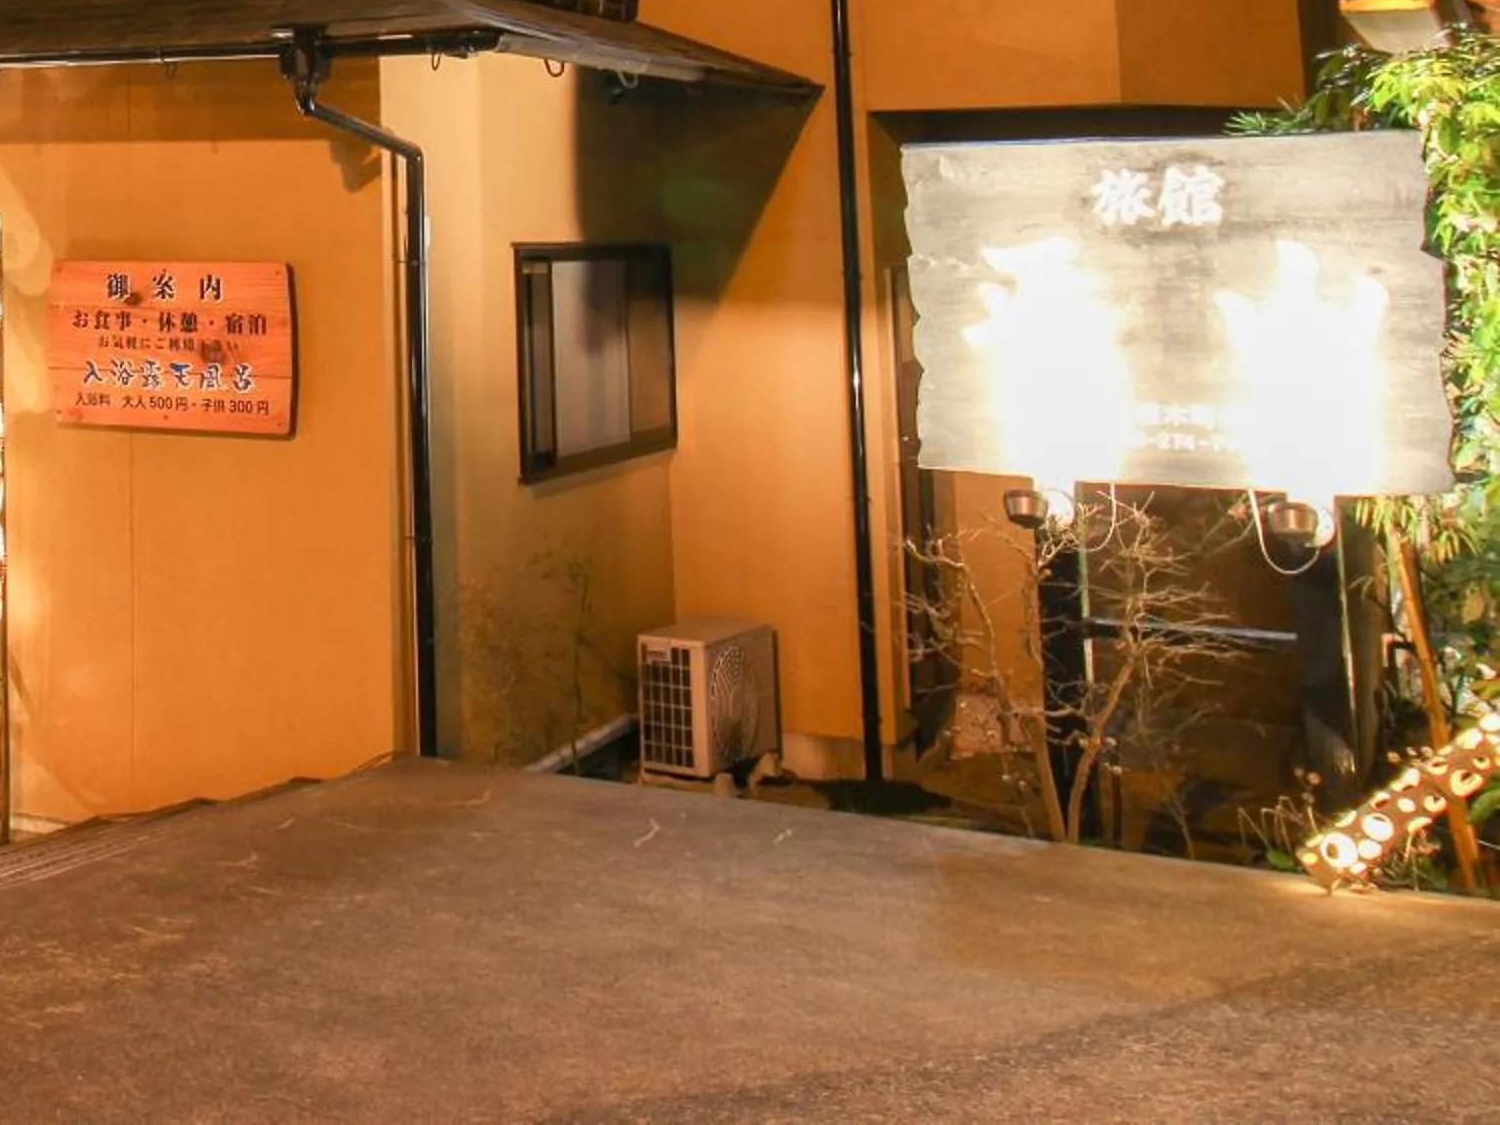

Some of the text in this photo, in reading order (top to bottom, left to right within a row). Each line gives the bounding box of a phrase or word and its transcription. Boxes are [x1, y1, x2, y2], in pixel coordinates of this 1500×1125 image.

[1091, 163, 1226, 228] 旅館
[106, 271, 224, 302] 御案内
[83, 359, 255, 393] 入浴露天風呂
